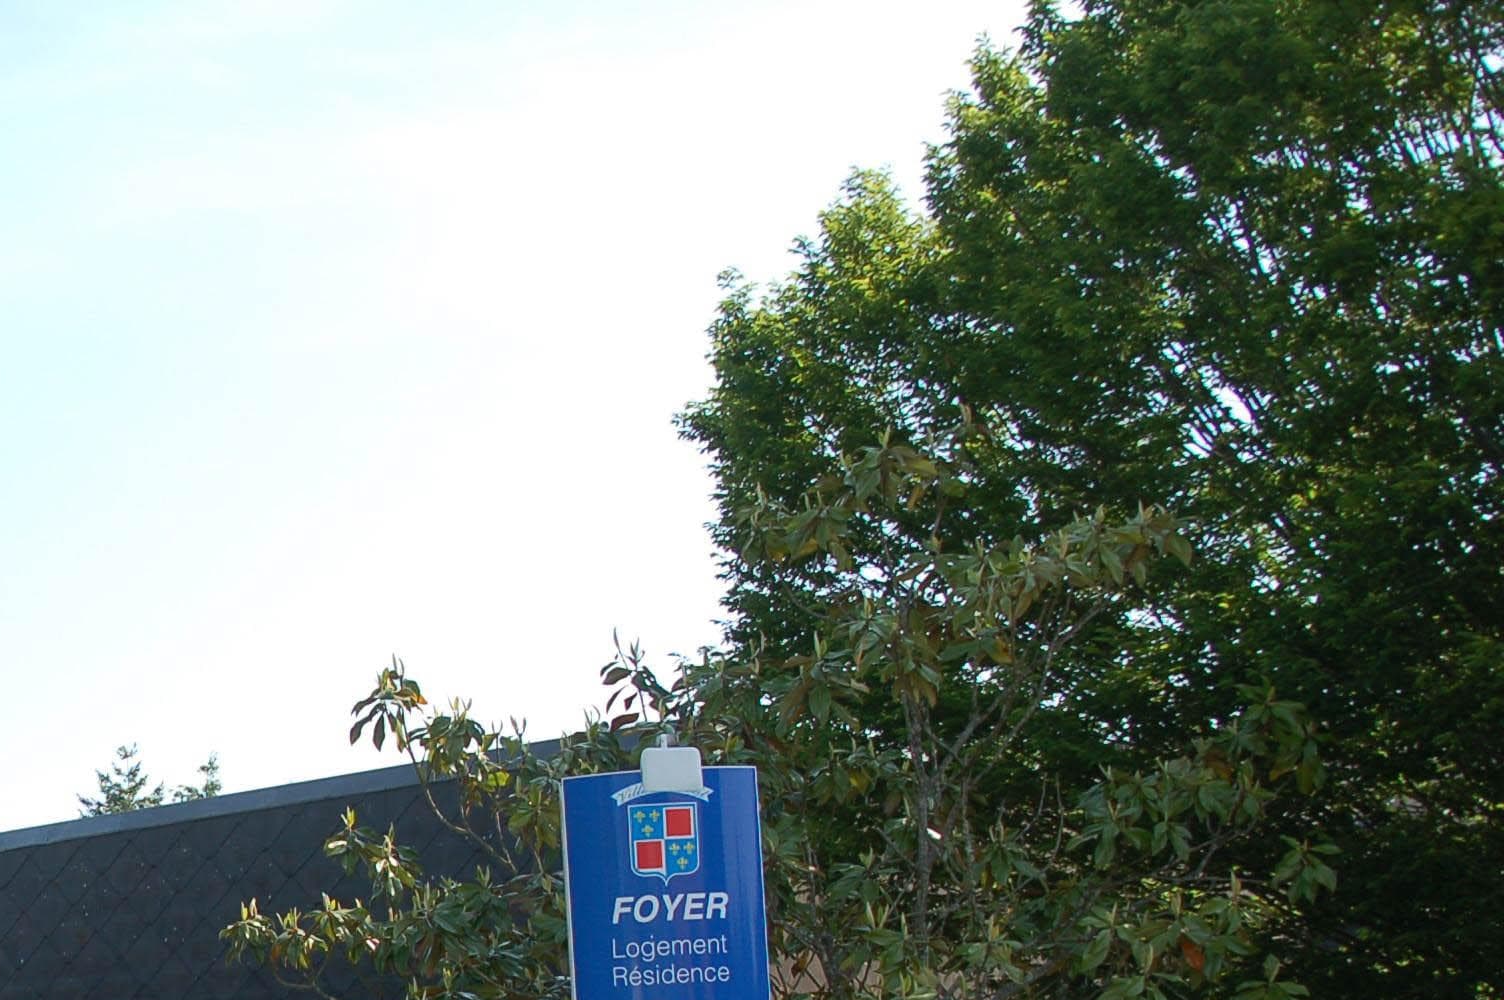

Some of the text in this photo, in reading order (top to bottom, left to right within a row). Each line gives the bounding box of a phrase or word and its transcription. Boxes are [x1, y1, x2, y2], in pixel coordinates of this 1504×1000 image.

[612, 892, 729, 925] FOYER
[612, 934, 728, 962] Logement
[613, 965, 730, 988] Résidence
